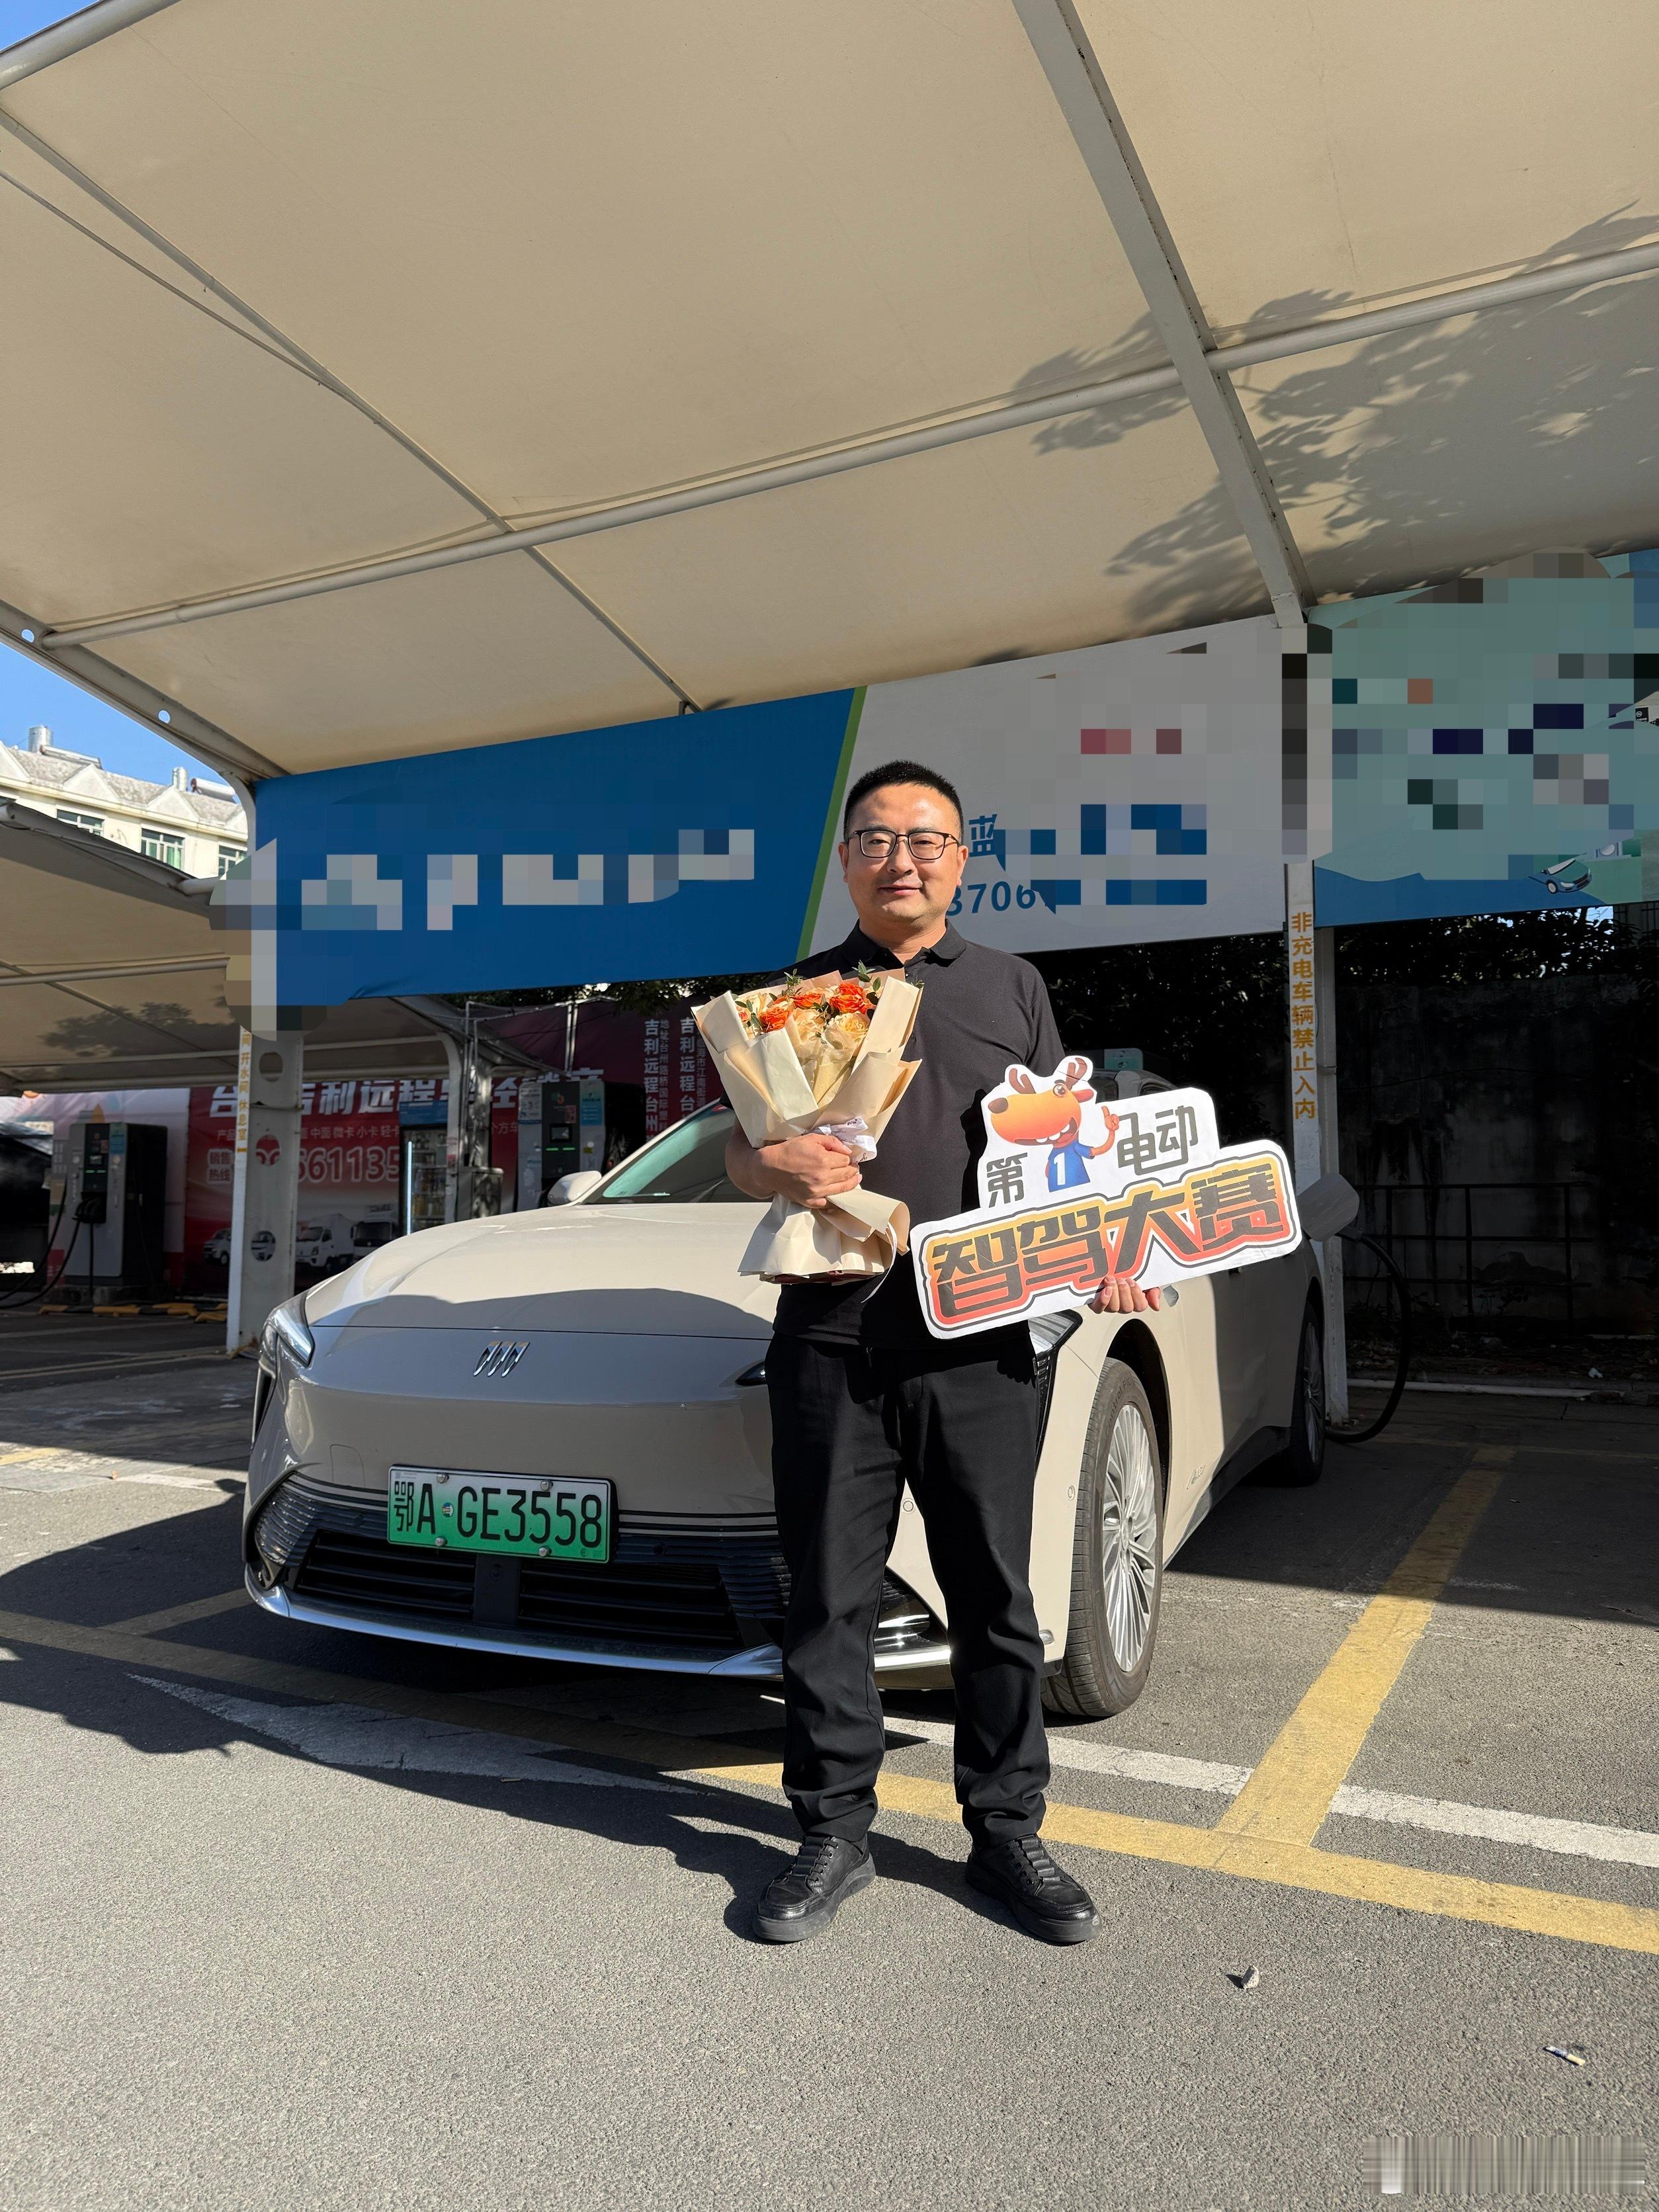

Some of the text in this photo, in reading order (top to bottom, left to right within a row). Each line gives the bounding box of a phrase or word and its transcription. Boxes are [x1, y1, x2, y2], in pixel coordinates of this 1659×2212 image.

[680, 1017, 696, 1119] 吉利远程台
[1291, 912, 1316, 1119] 非充电车辆禁止入内
[931, 1163, 1285, 1318] 智驾大赛
